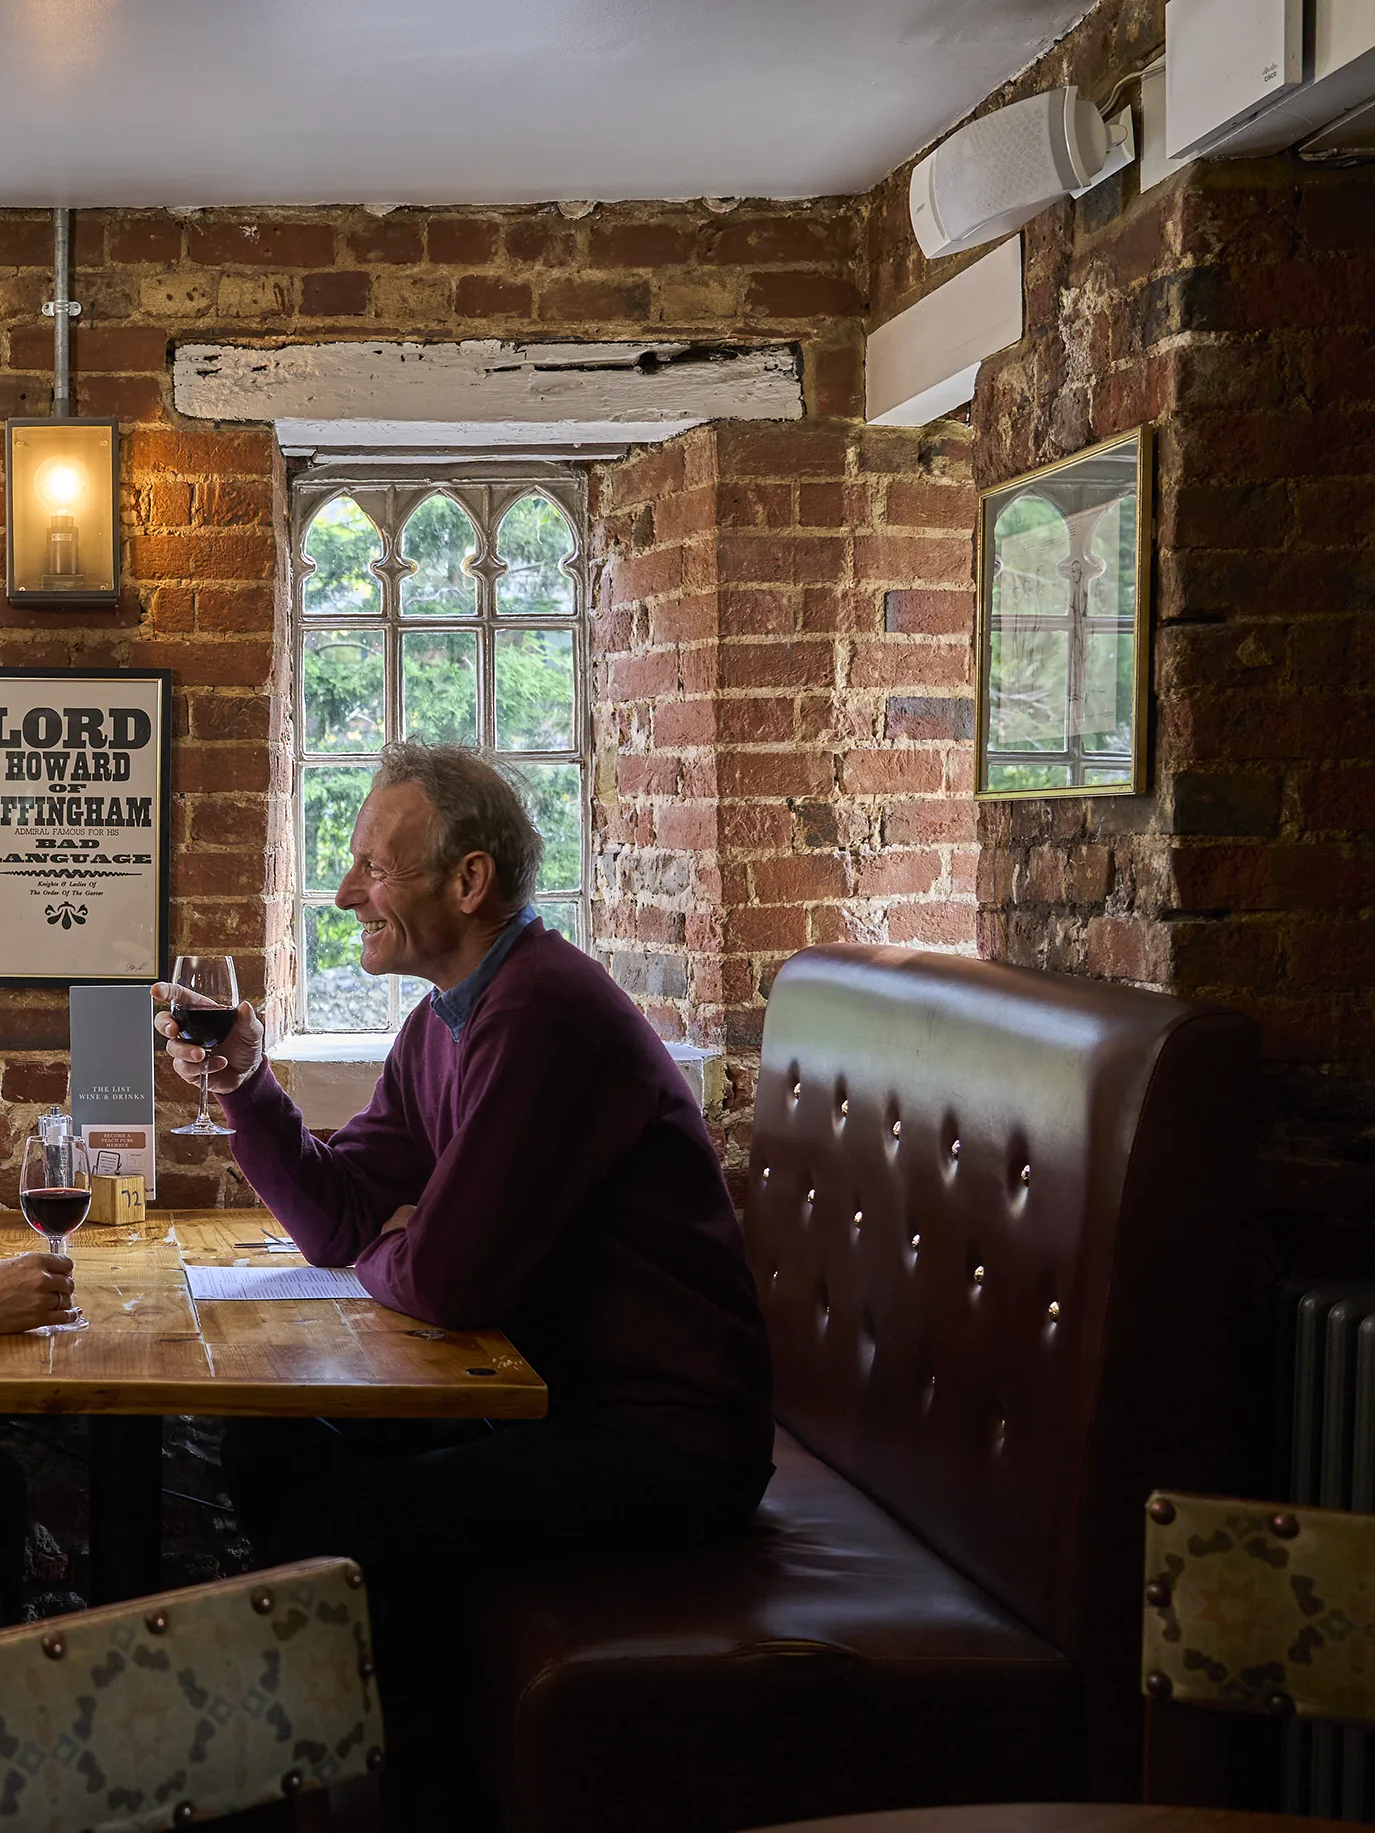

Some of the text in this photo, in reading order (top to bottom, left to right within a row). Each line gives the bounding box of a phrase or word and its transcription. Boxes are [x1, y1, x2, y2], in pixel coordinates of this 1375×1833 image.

[5, 751, 130, 781] HOWARD
[48, 783, 87, 793] OF
[14, 828, 49, 836] ADMIRAL
[52, 828, 85, 836] FAMOUS
[35, 838, 100, 849] BAD
[121, 1189, 143, 1208] 72
